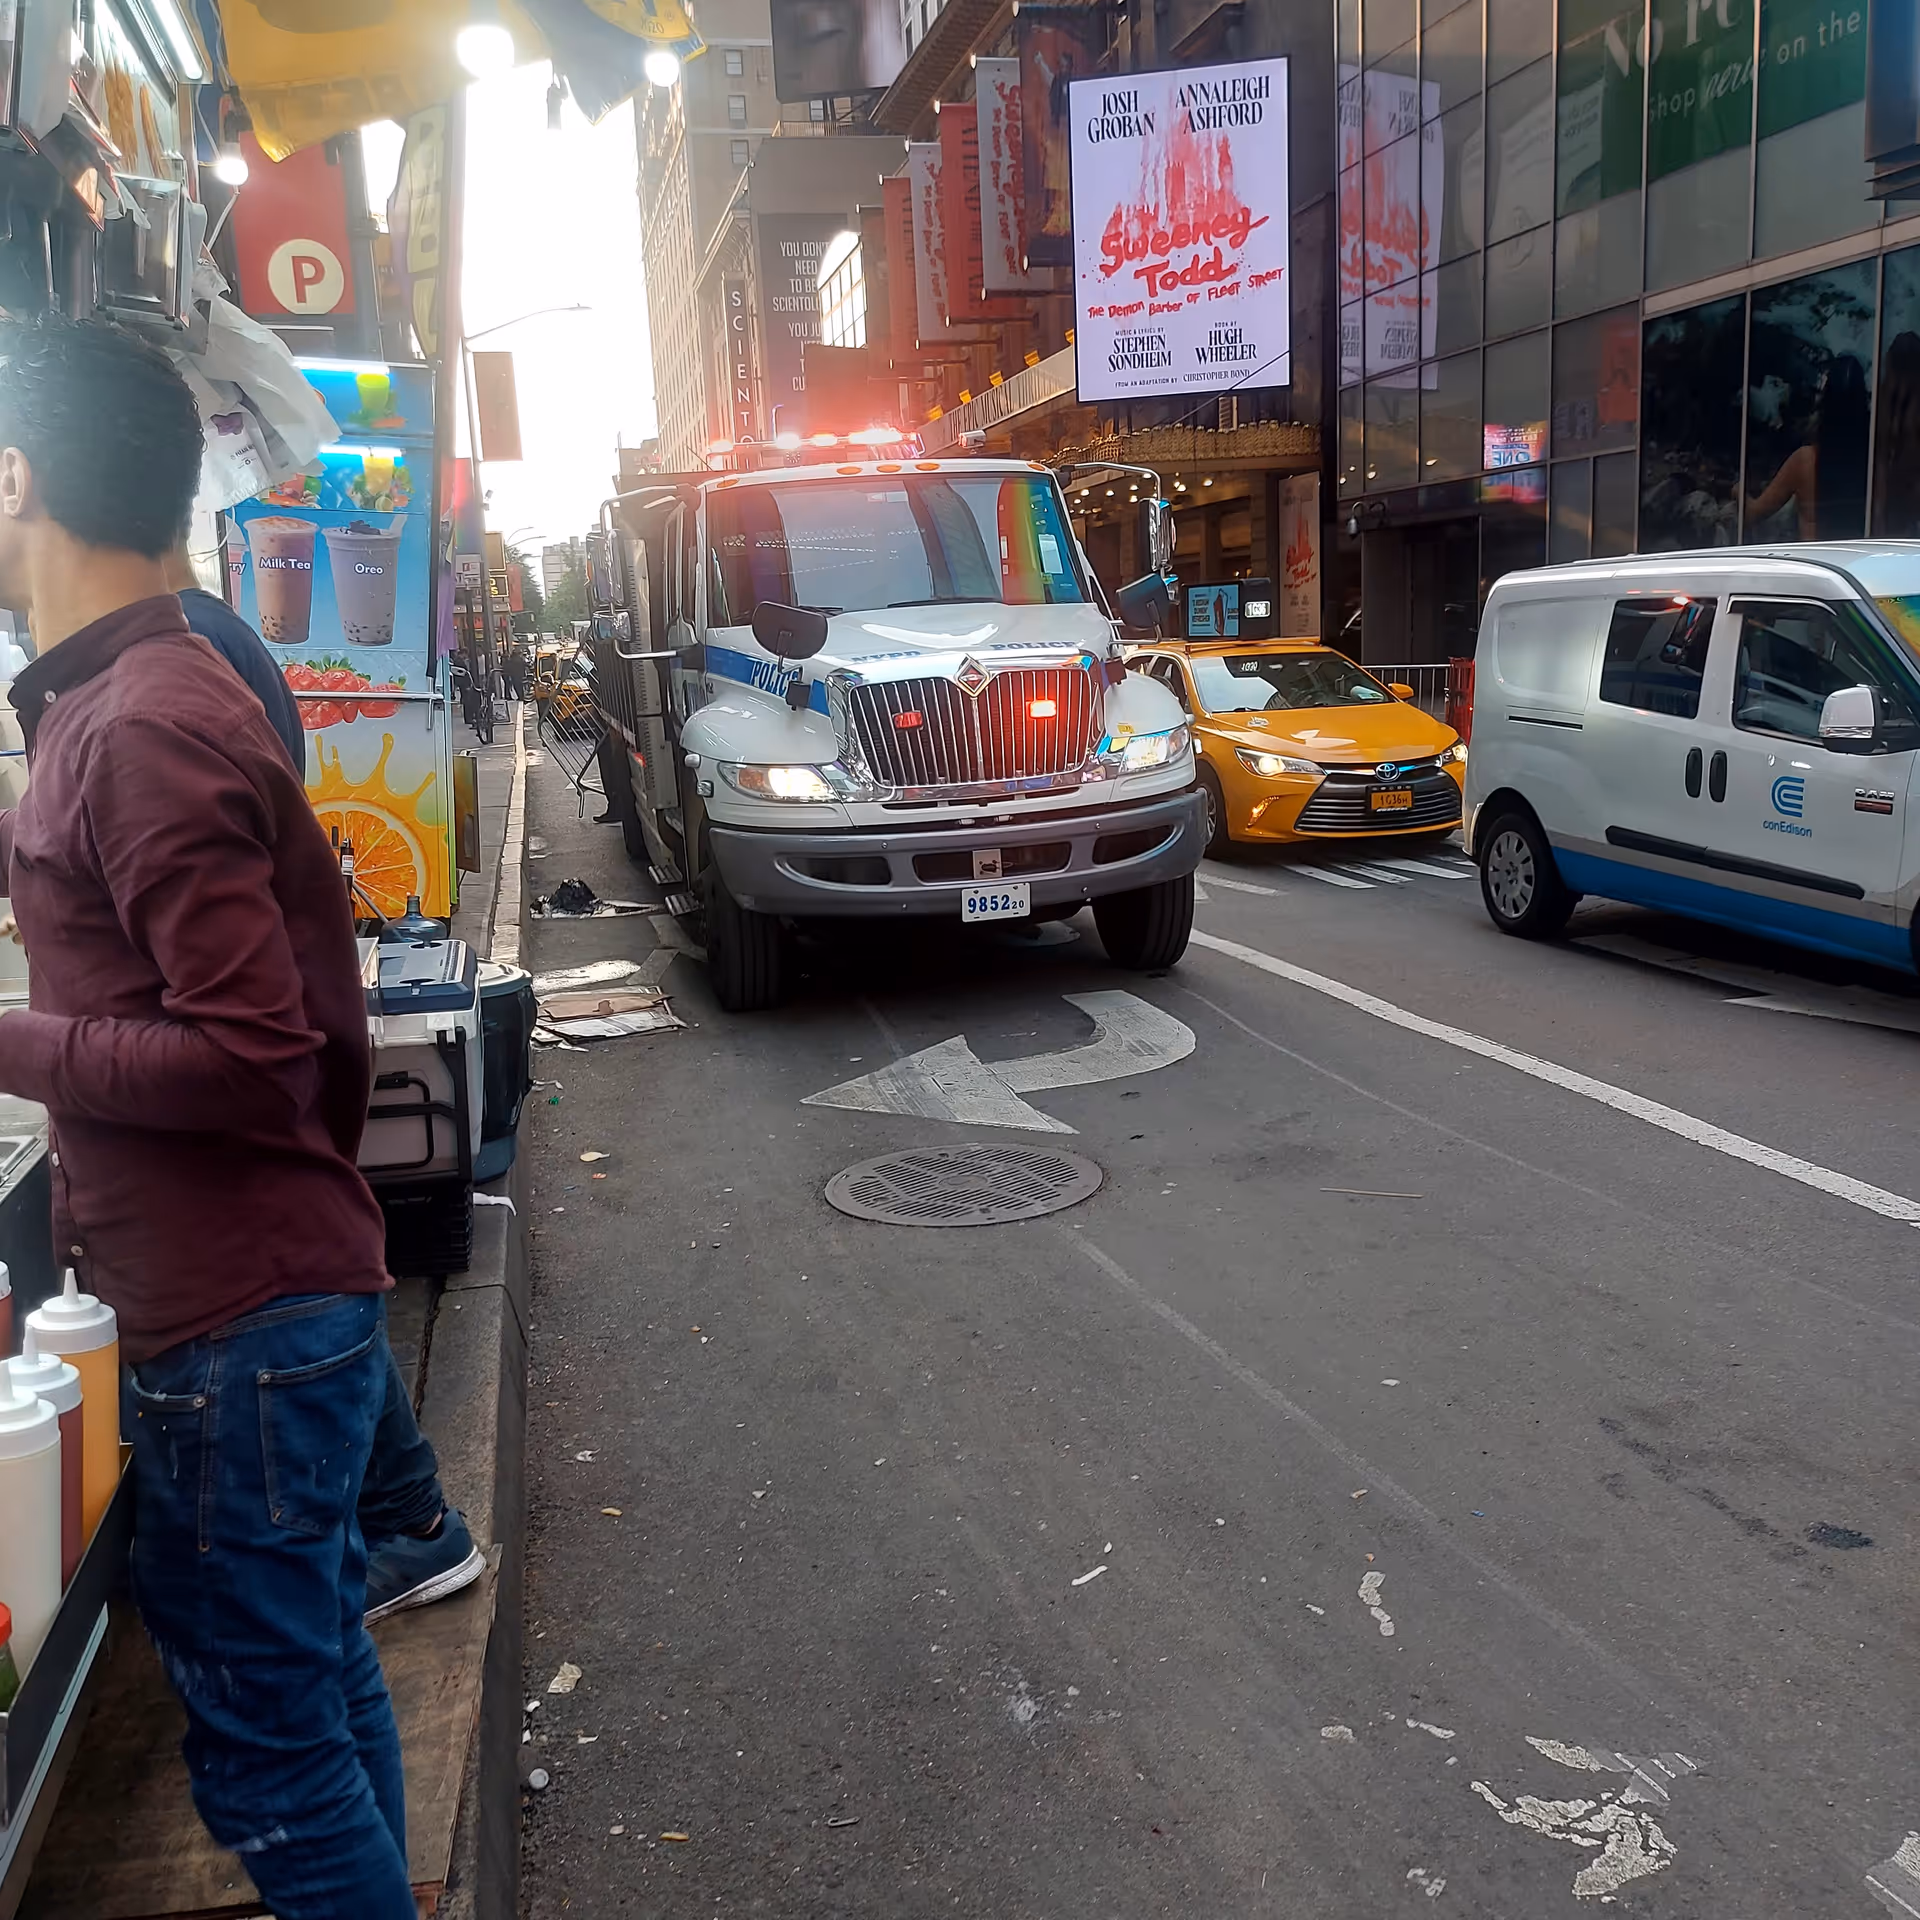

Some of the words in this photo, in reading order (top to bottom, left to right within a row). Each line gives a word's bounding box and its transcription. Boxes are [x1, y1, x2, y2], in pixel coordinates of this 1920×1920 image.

[1777, 36, 1806, 65] on
[1818, 10, 1861, 48] the
[1175, 75, 1270, 108] ANNALEIGH
[1101, 90, 1138, 117] JOSH
[1087, 112, 1155, 144] GROBAN
[1183, 102, 1263, 134] ASHFORD
[780, 241, 800, 257] YOU
[1099, 206, 1269, 278] Sweeney
[795, 260, 818, 275] NEED
[1133, 246, 1238, 298] Todd
[290, 255, 325, 304] P
[789, 278, 802, 293] TO
[804, 278, 817, 293] BE
[788, 322, 808, 337] YOU
[810, 322, 821, 337] JU
[1209, 328, 1243, 346] HUGH
[1113, 334, 1166, 354] STEPHEN
[1195, 343, 1258, 365] WHEELER
[1108, 350, 1172, 373] SONDHEIM
[1183, 371, 1229, 383] CHRISTOPHER
[1230, 368, 1250, 380] BOND
[259, 556, 286, 569] Milk
[287, 558, 311, 570] Tea
[354, 563, 384, 575] Oreo
[989, 640, 1077, 651] POLICE
[1762, 820, 1812, 838] conEdison
[967, 894, 1010, 914] 9852
